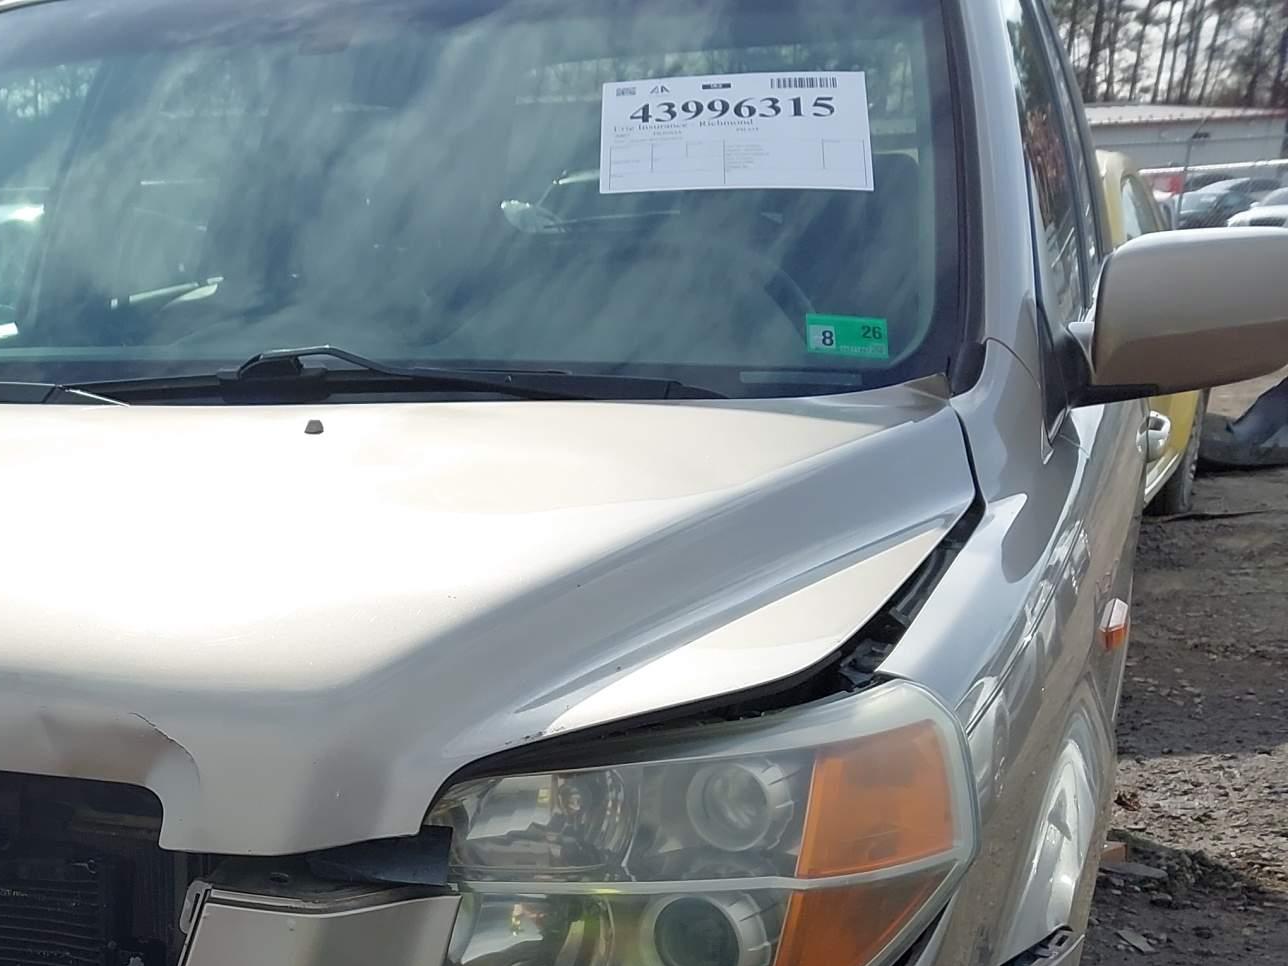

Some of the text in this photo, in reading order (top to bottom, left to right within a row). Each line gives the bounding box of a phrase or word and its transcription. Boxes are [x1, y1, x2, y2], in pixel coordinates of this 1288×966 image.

[630, 96, 835, 123] 43996315
[822, 330, 834, 346] 8
[861, 325, 883, 340] 26
